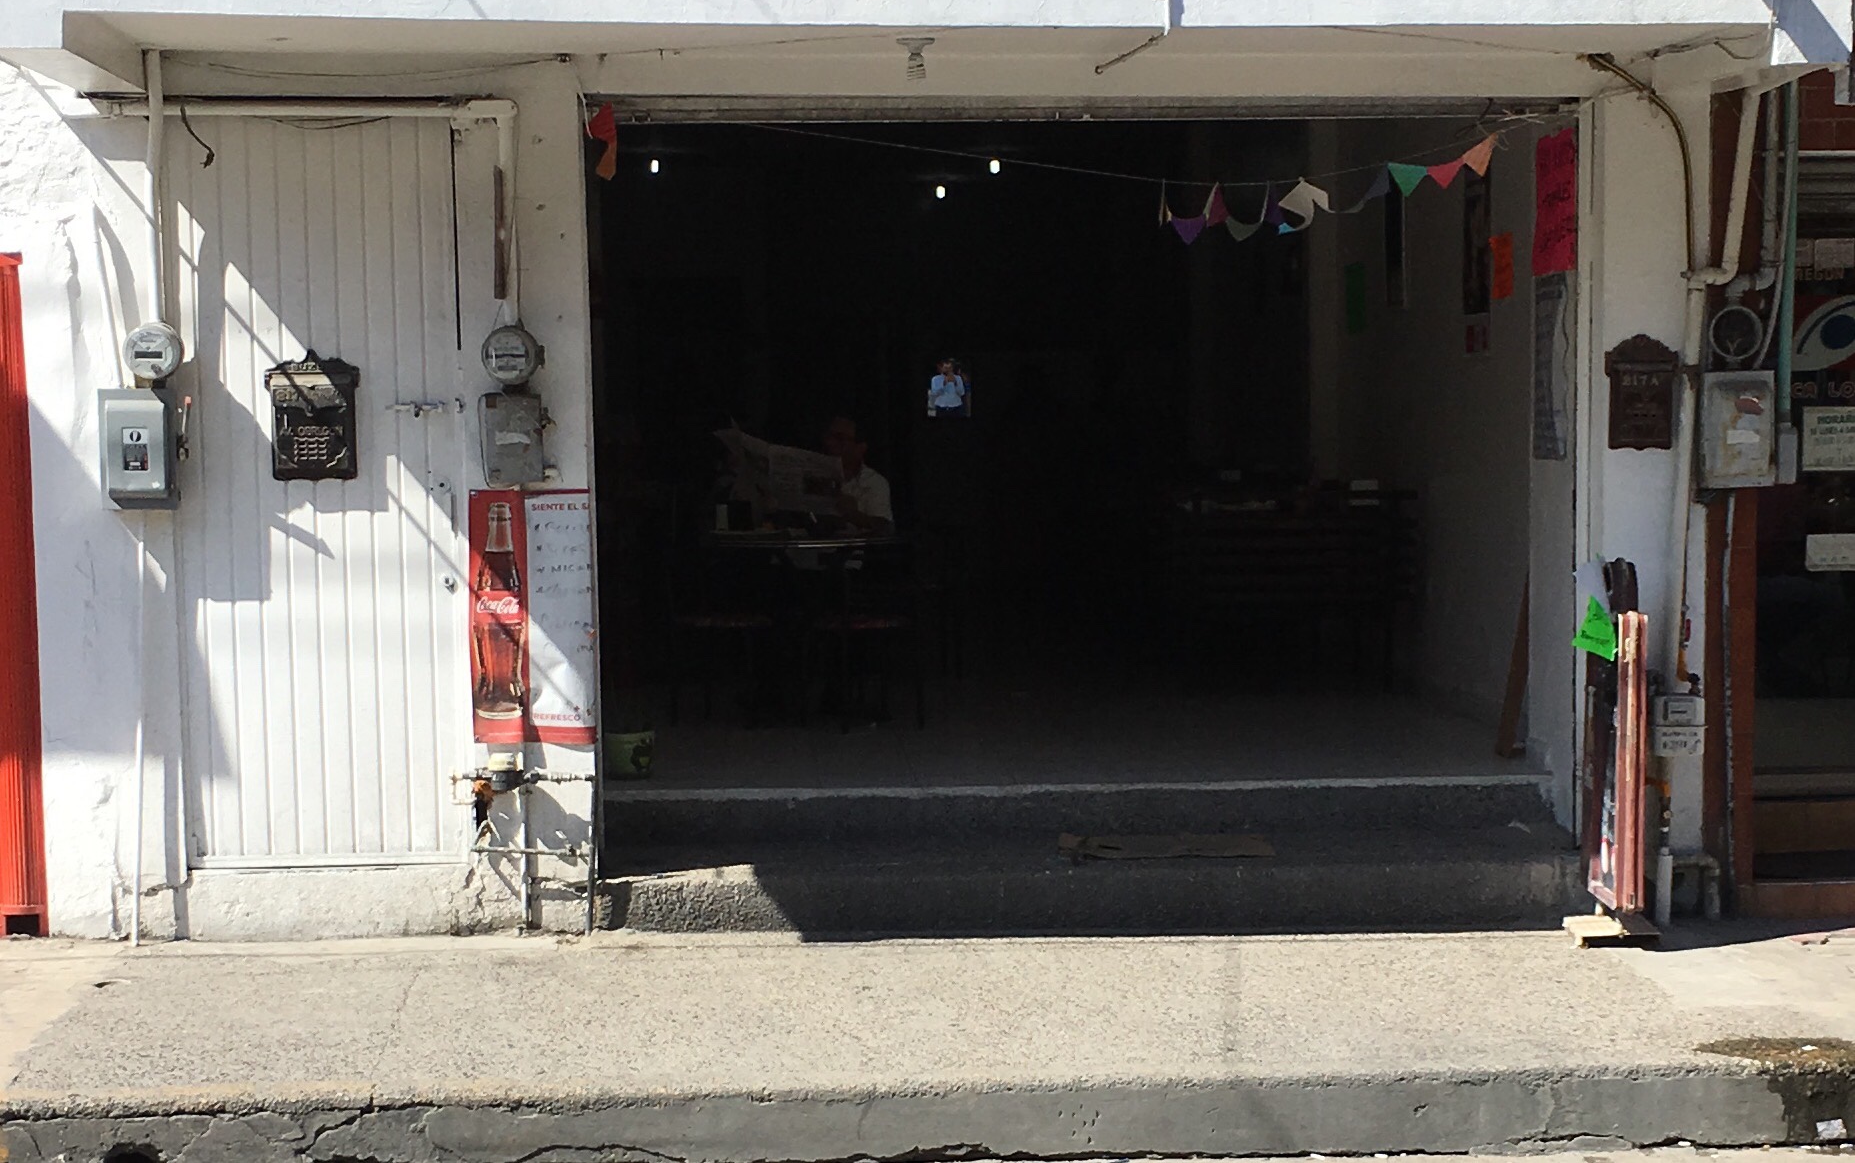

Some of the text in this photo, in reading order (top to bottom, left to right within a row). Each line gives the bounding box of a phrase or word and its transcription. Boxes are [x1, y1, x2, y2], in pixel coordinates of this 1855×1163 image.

[532, 503, 565, 512] SIENTE
[567, 503, 579, 511] EL
[533, 713, 581, 722] REFRESCO
